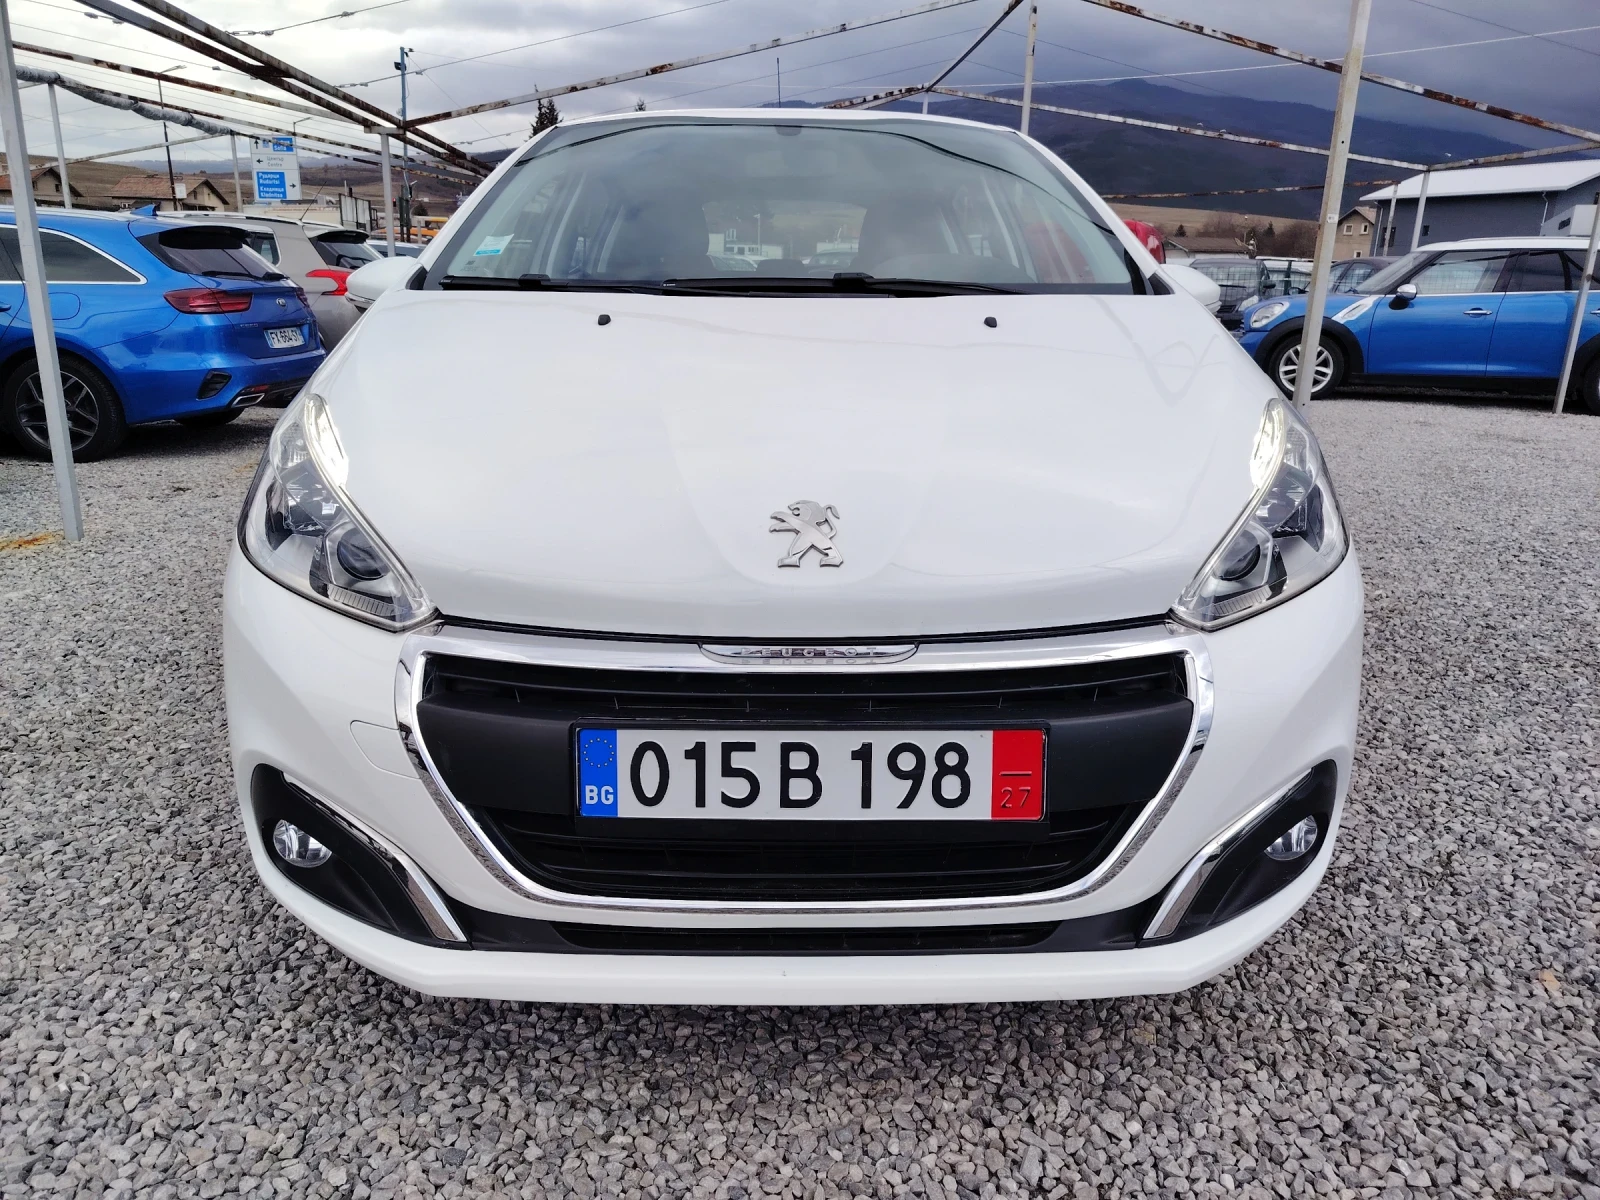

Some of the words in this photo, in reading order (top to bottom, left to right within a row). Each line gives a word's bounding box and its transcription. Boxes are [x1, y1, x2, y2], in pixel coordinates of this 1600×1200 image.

[741, 647, 877, 657] PEUGEOT
[584, 784, 614, 805] BG
[1000, 786, 1032, 809] 27
